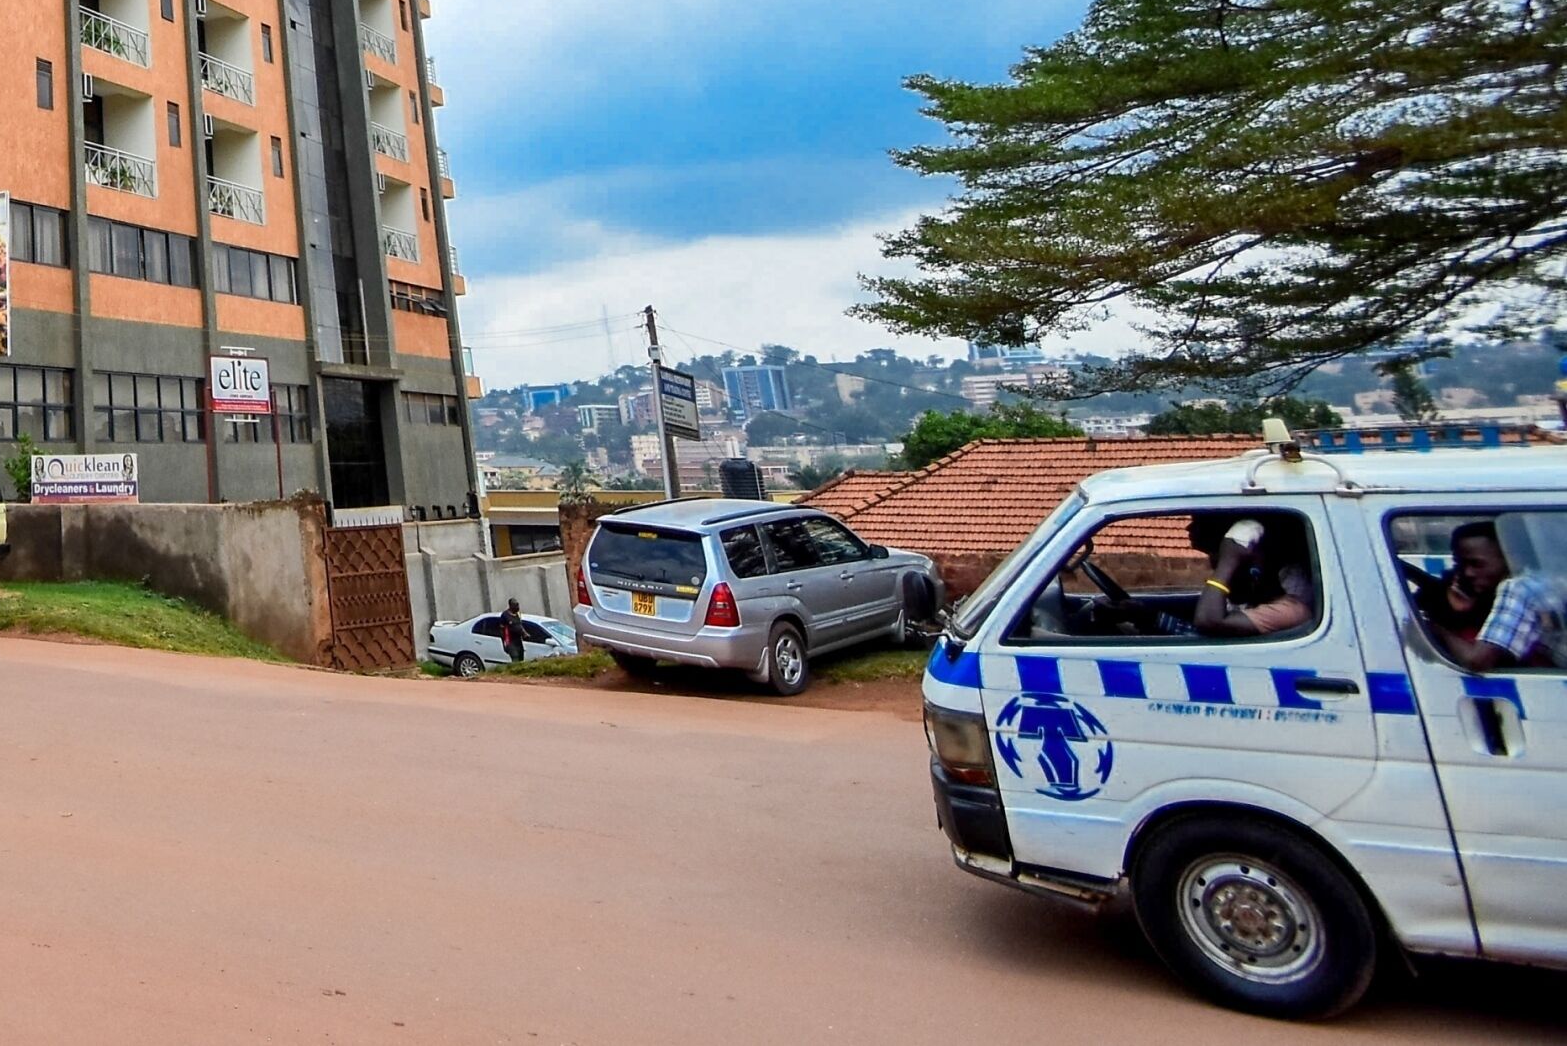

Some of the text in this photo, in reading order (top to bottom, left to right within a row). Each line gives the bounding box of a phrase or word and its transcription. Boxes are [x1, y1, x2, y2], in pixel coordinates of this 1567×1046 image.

[218, 360, 263, 391] elite
[48, 457, 120, 480] Quicklean
[34, 484, 88, 495] Drycleaners
[95, 483, 134, 495] Laundry
